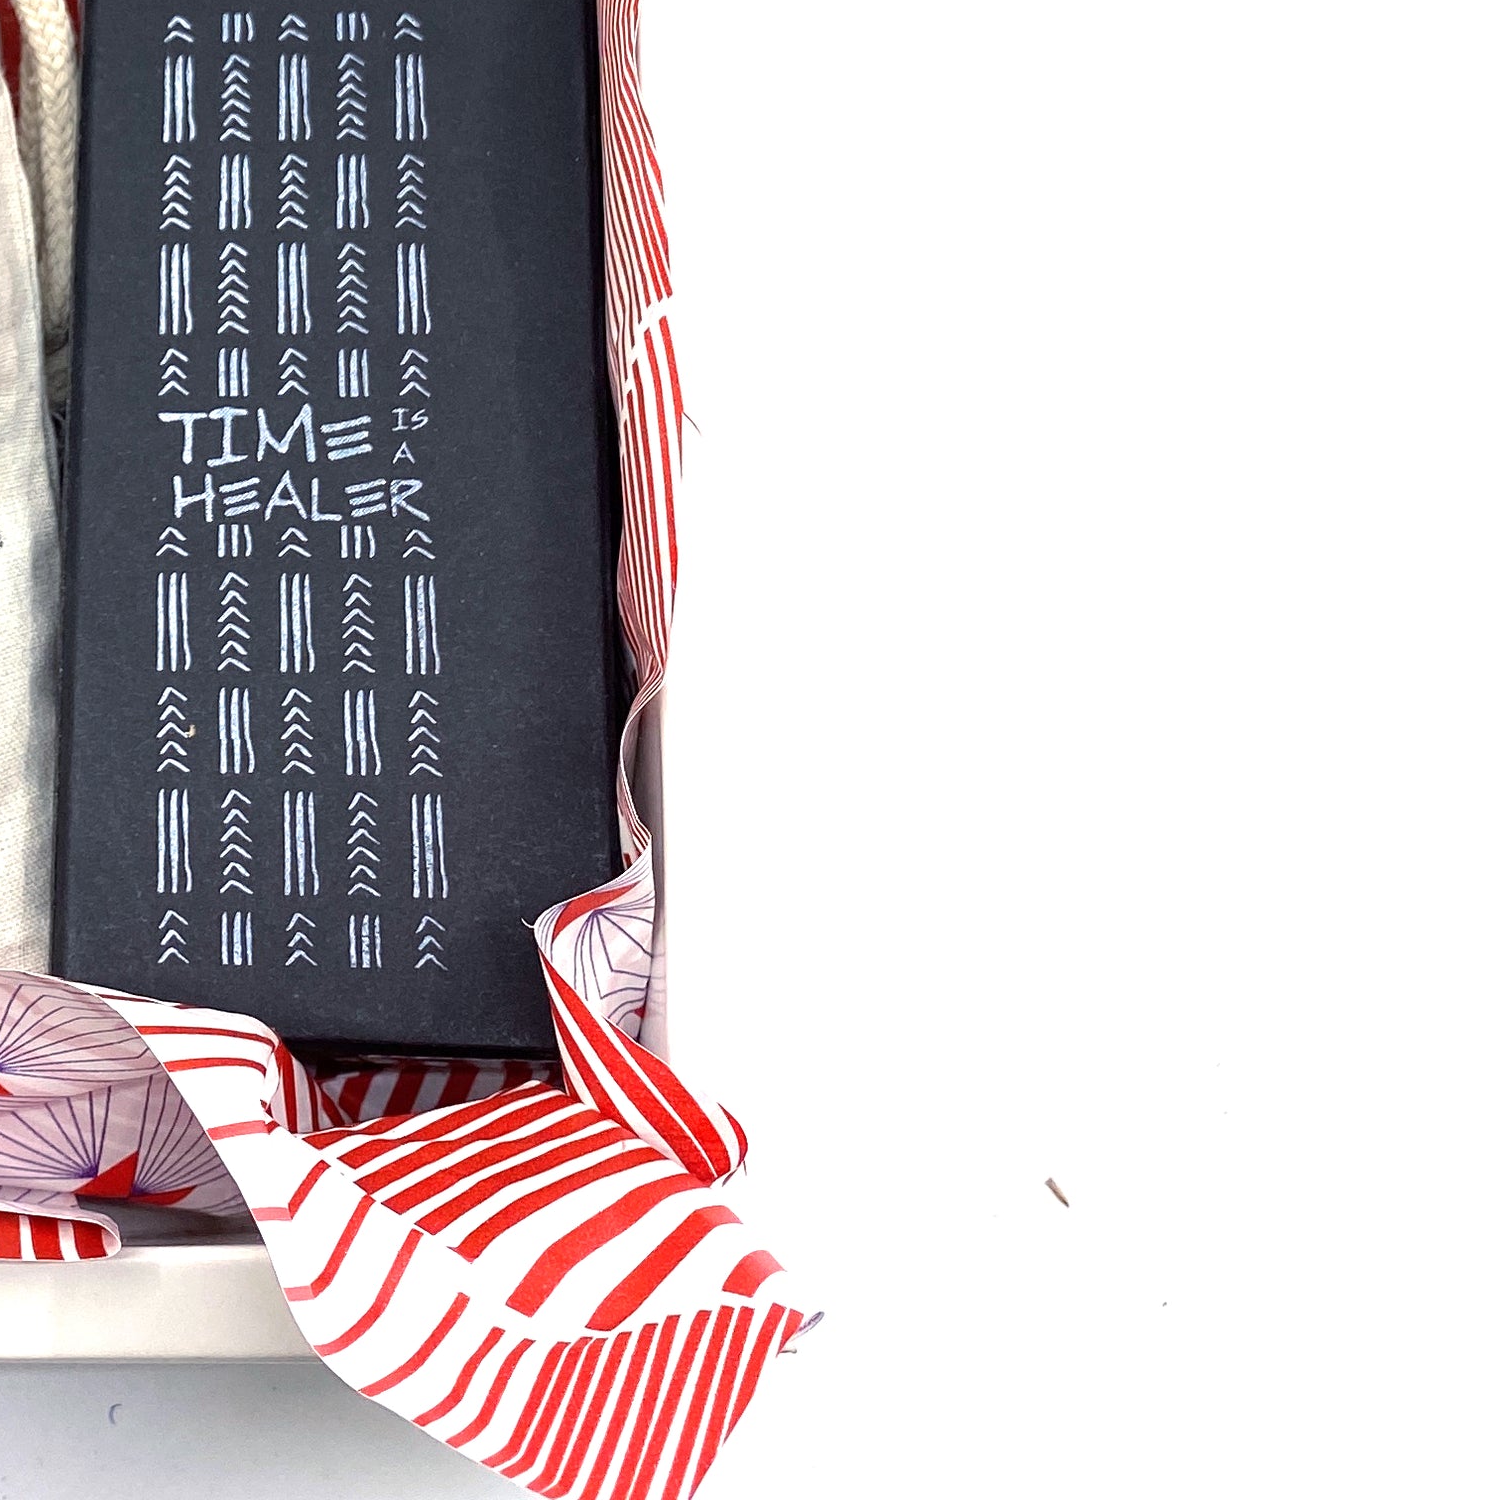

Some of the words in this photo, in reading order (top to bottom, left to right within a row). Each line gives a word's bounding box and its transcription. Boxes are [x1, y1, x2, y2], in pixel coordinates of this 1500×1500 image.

[158, 403, 373, 467] TIME
[392, 407, 429, 432] IS
[392, 442, 415, 464] A
[173, 470, 430, 522] HEALER
